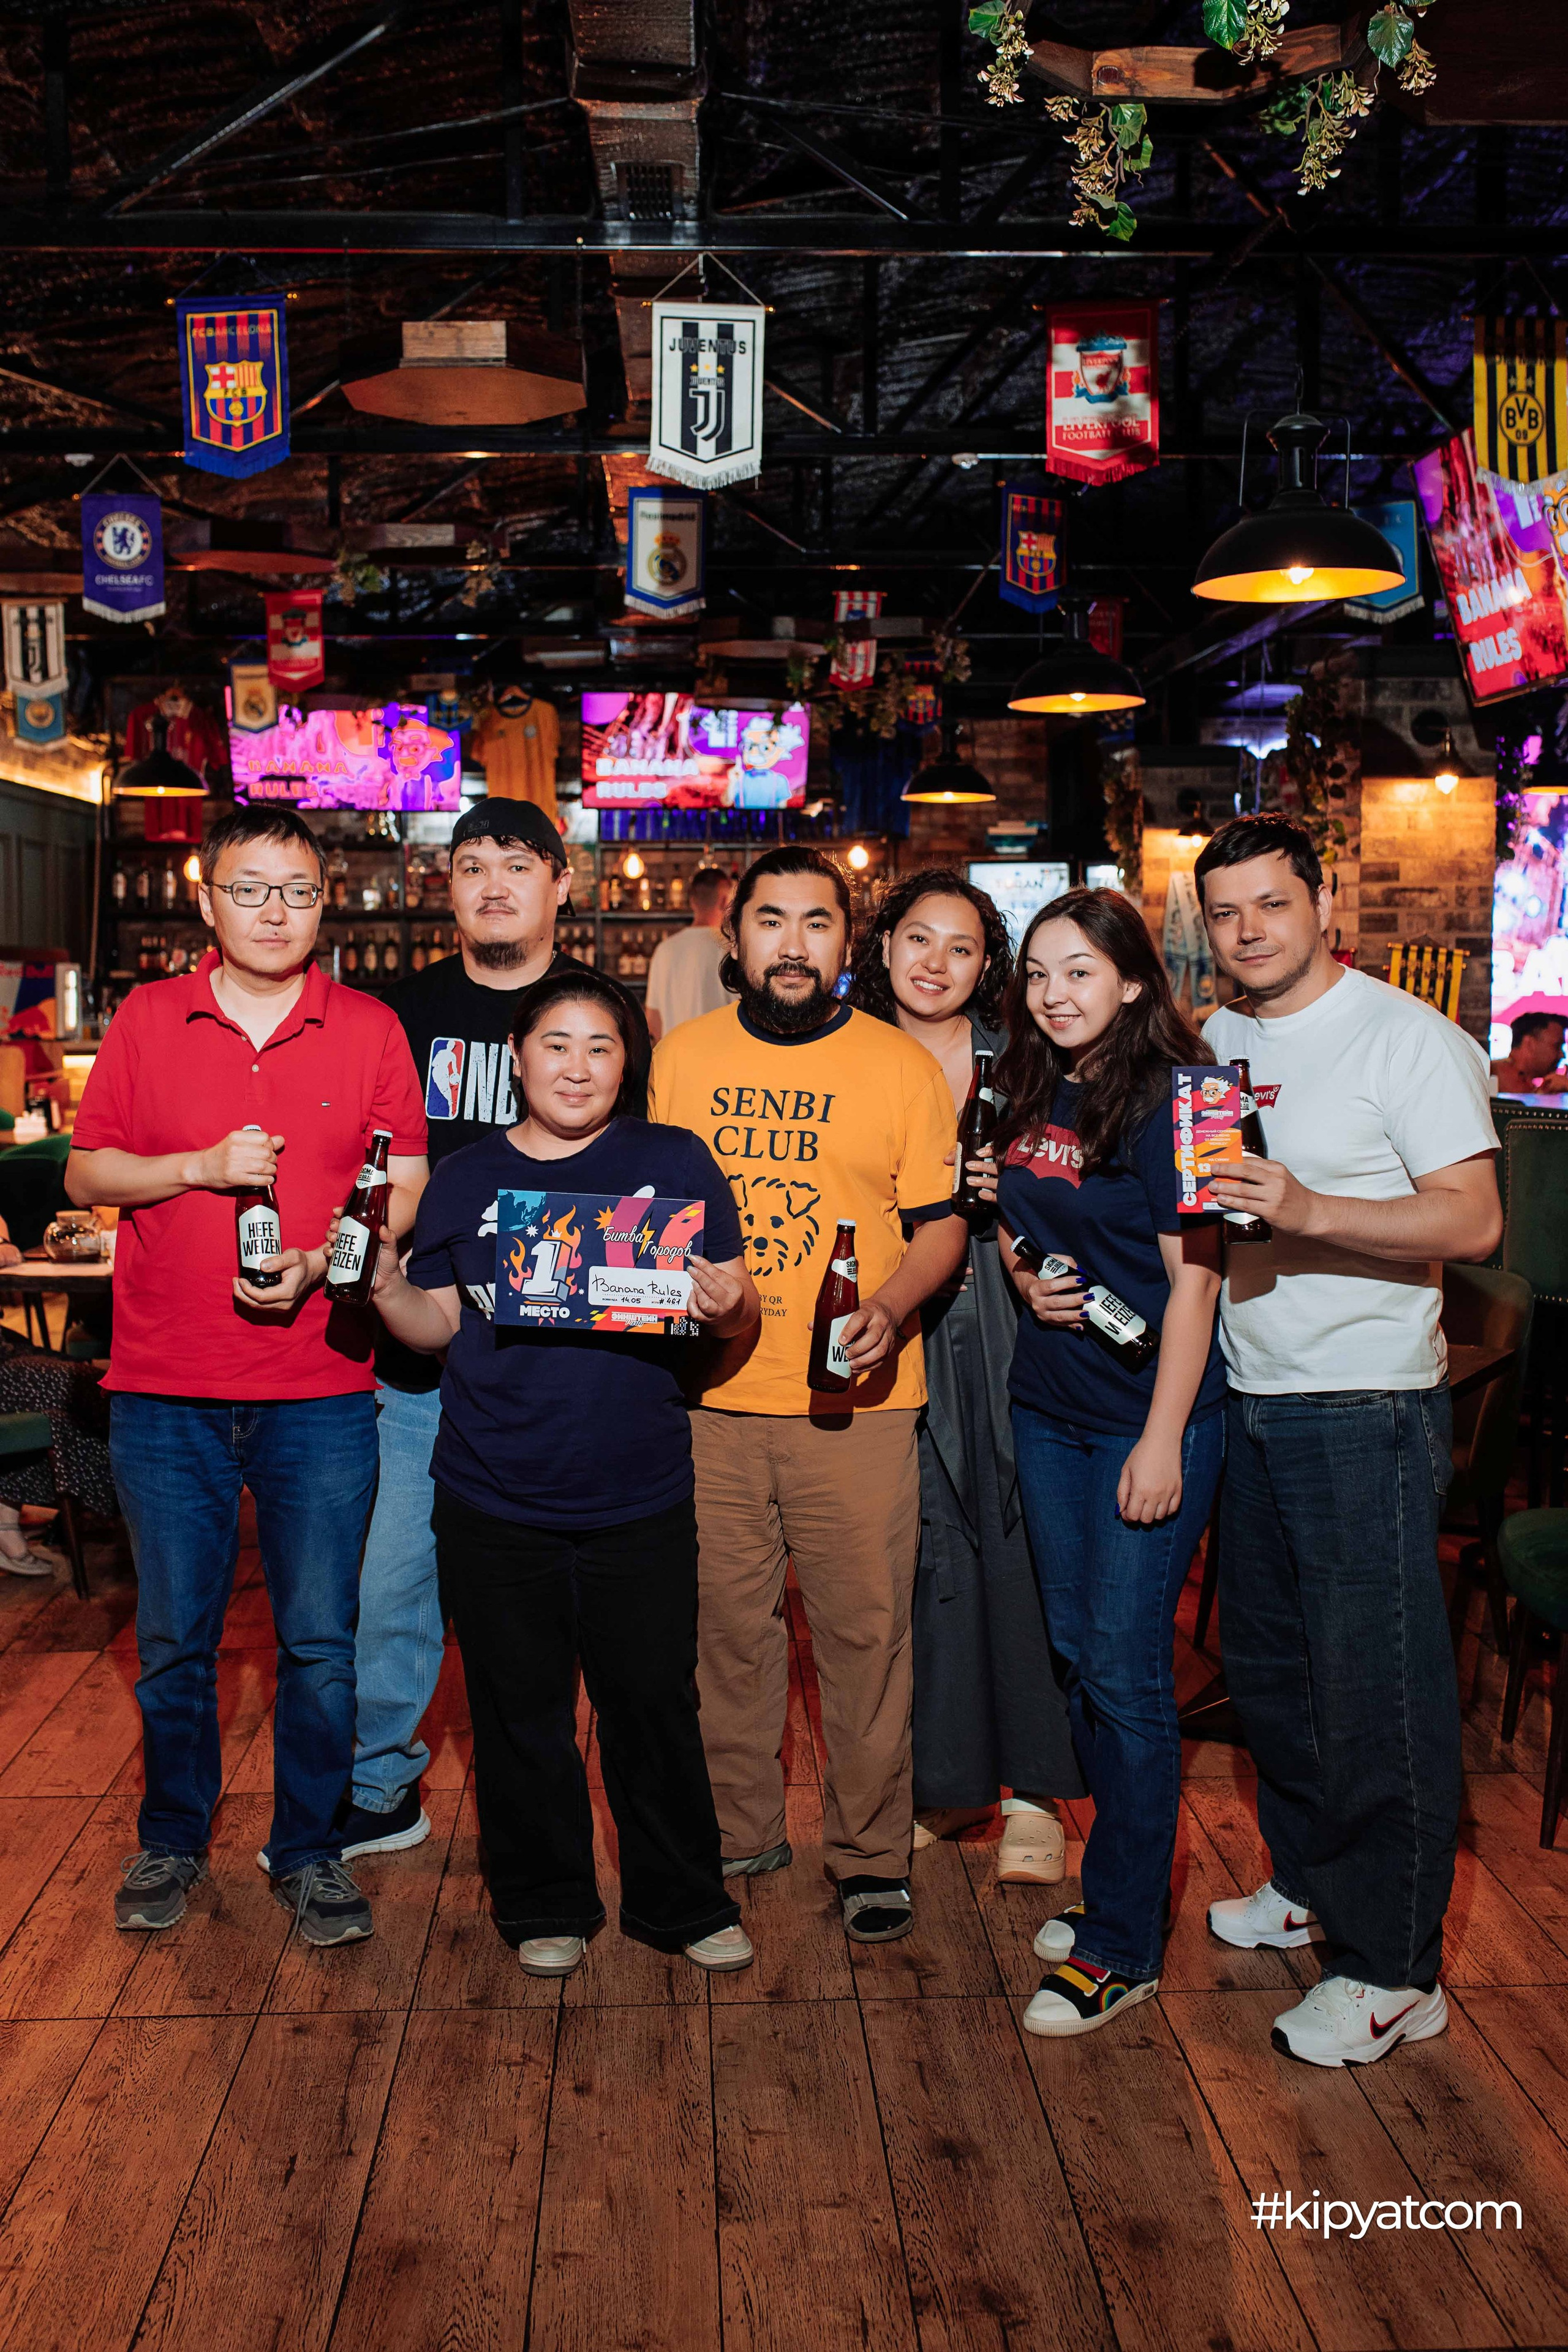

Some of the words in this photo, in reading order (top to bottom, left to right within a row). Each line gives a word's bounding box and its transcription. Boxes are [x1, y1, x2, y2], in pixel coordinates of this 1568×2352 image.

[669, 337, 747, 355] JUVENTUS
[1506, 398, 1539, 429] BVB
[1457, 567, 1532, 625] BANANA
[1469, 627, 1522, 673] RULES
[595, 757, 699, 776] BANANA
[595, 781, 667, 799] RULES
[463, 1041, 518, 1125] NB
[710, 1087, 836, 1123] SENBI
[1254, 1090, 1275, 1101] evi's
[713, 1125, 820, 1162] CLUB
[1177, 1073, 1197, 1207] СЕРТИФИКАТ
[248, 1221, 274, 1238] HEFE
[603, 1225, 644, 1243] Битва
[243, 1238, 281, 1257] WEIZEN
[643, 1240, 693, 1264] Городов
[521, 1240, 562, 1296] 1
[592, 1274, 645, 1295] Banana
[647, 1280, 682, 1297] Rules
[519, 1305, 570, 1319] МЕСТО
[760, 1307, 788, 1317] RYDAY
